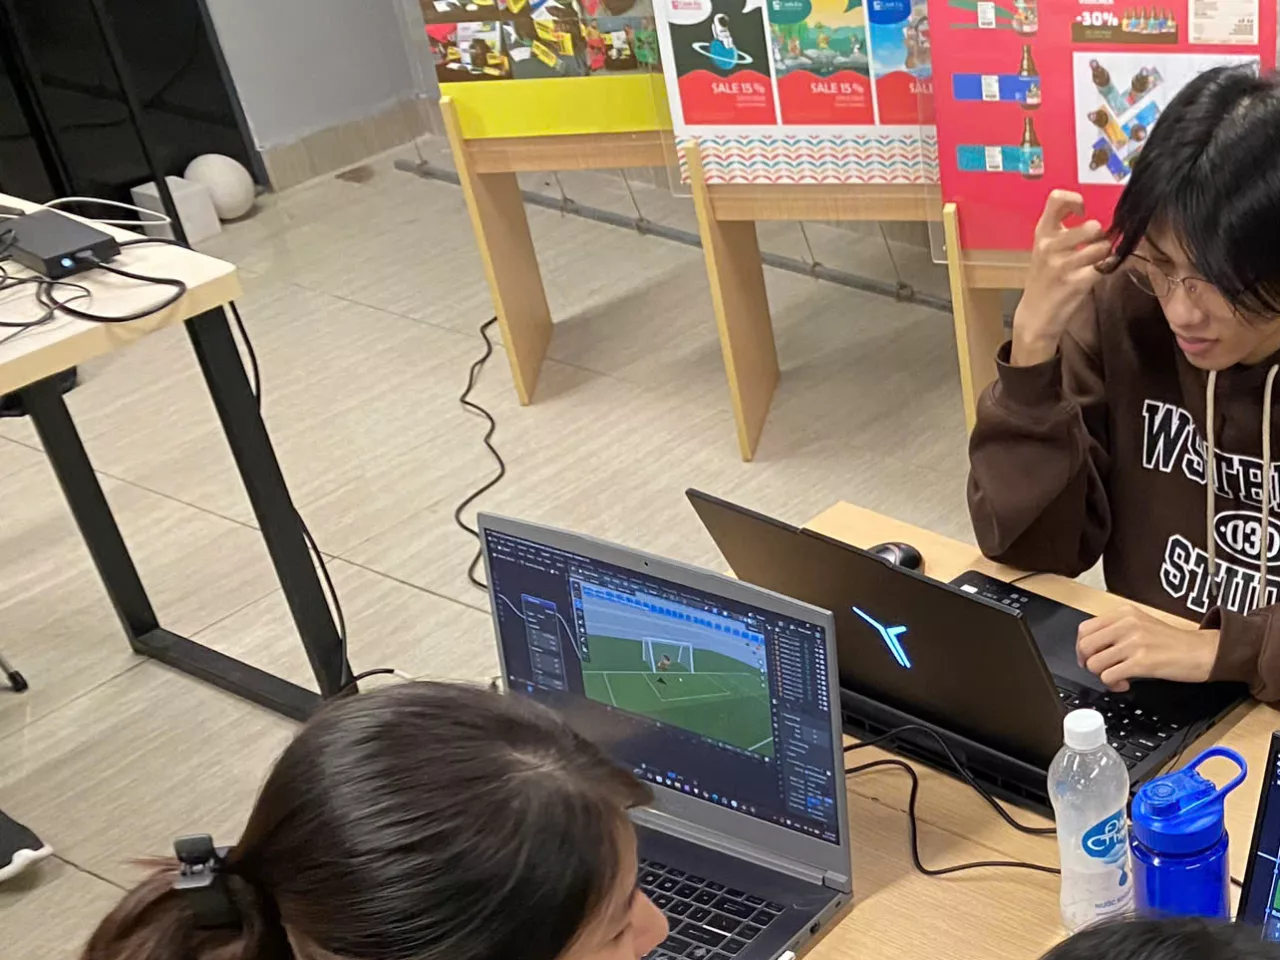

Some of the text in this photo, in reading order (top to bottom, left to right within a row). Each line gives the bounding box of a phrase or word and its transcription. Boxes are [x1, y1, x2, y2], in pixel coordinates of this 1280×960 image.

[1076, 11, 1119, 26] -30%
[711, 81, 740, 95] SALE
[741, 82, 752, 95] 15
[810, 81, 839, 95] SALE
[840, 82, 851, 95] 15
